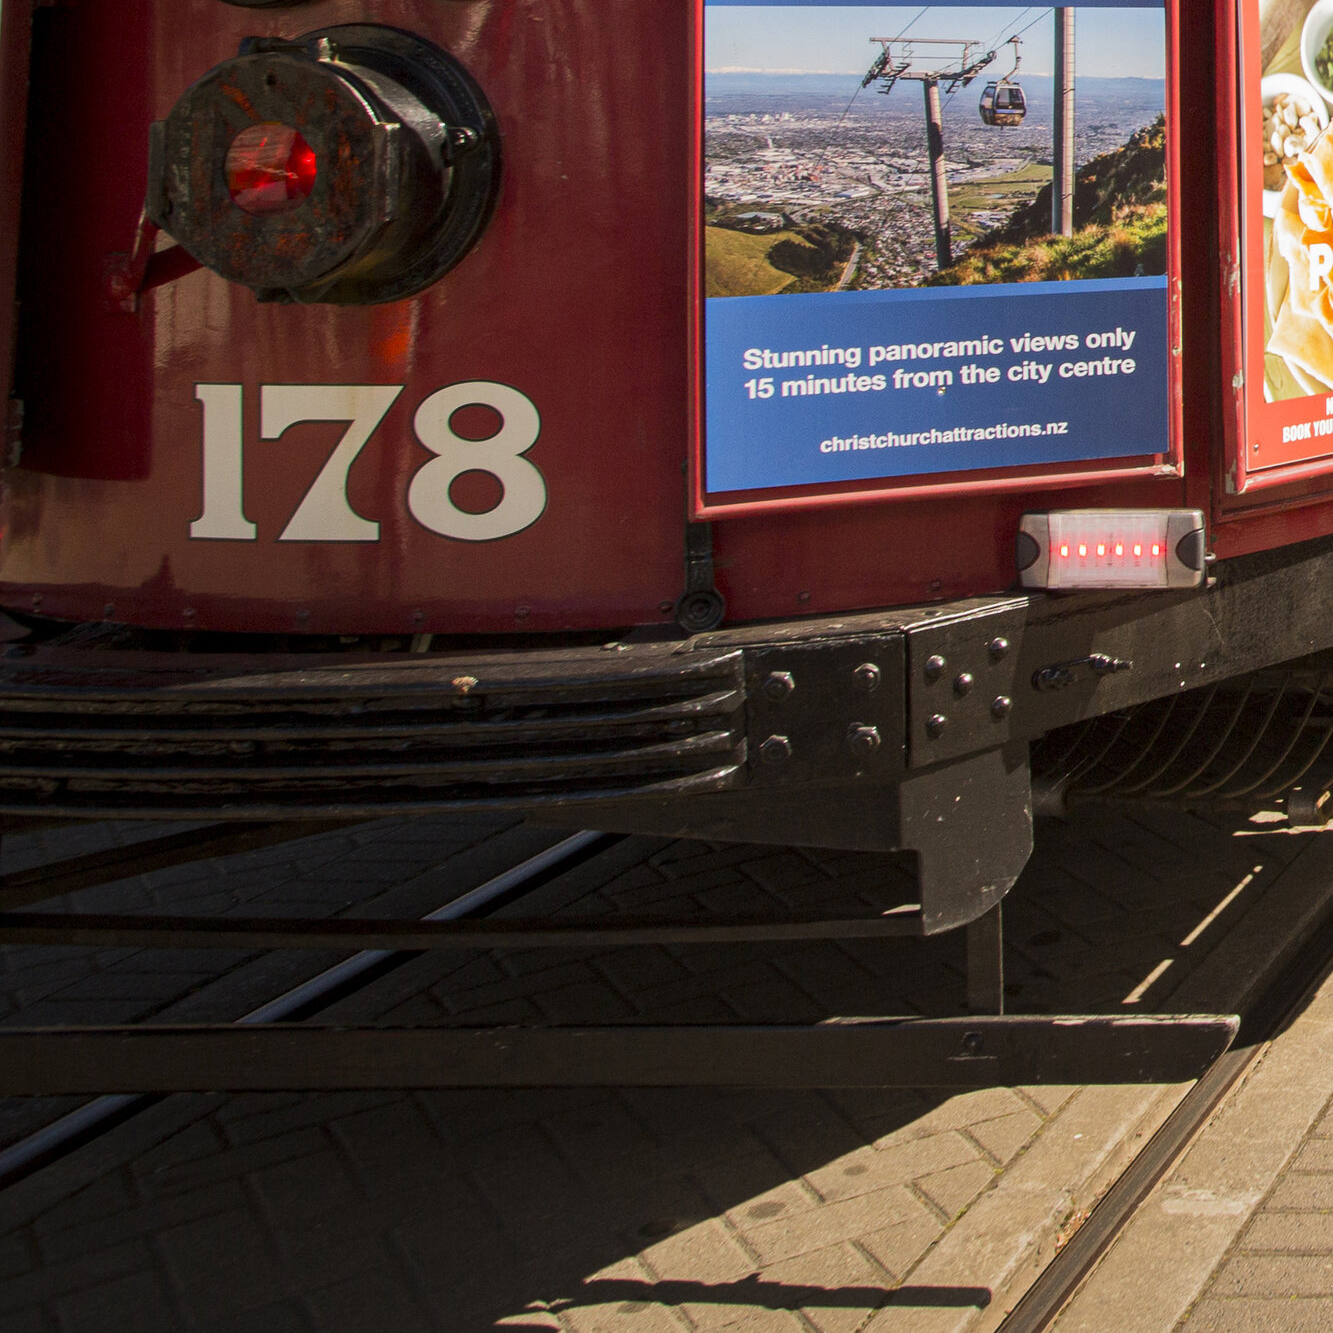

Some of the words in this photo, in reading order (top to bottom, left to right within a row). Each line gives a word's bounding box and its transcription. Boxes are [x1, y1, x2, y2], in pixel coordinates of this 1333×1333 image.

[743, 344, 862, 370] Stunning
[869, 335, 1004, 366] panoramic
[1010, 333, 1080, 353] views
[1085, 327, 1136, 351] only
[744, 377, 775, 399] 15
[781, 374, 887, 397] minutes
[892, 368, 953, 389] from
[960, 364, 1001, 384] the
[1007, 360, 1053, 384] city
[1058, 356, 1136, 378] centre
[820, 421, 1068, 453] christchurchattractions.nz
[1282, 422, 1312, 443] BOOK
[188, 378, 548, 543] 178
